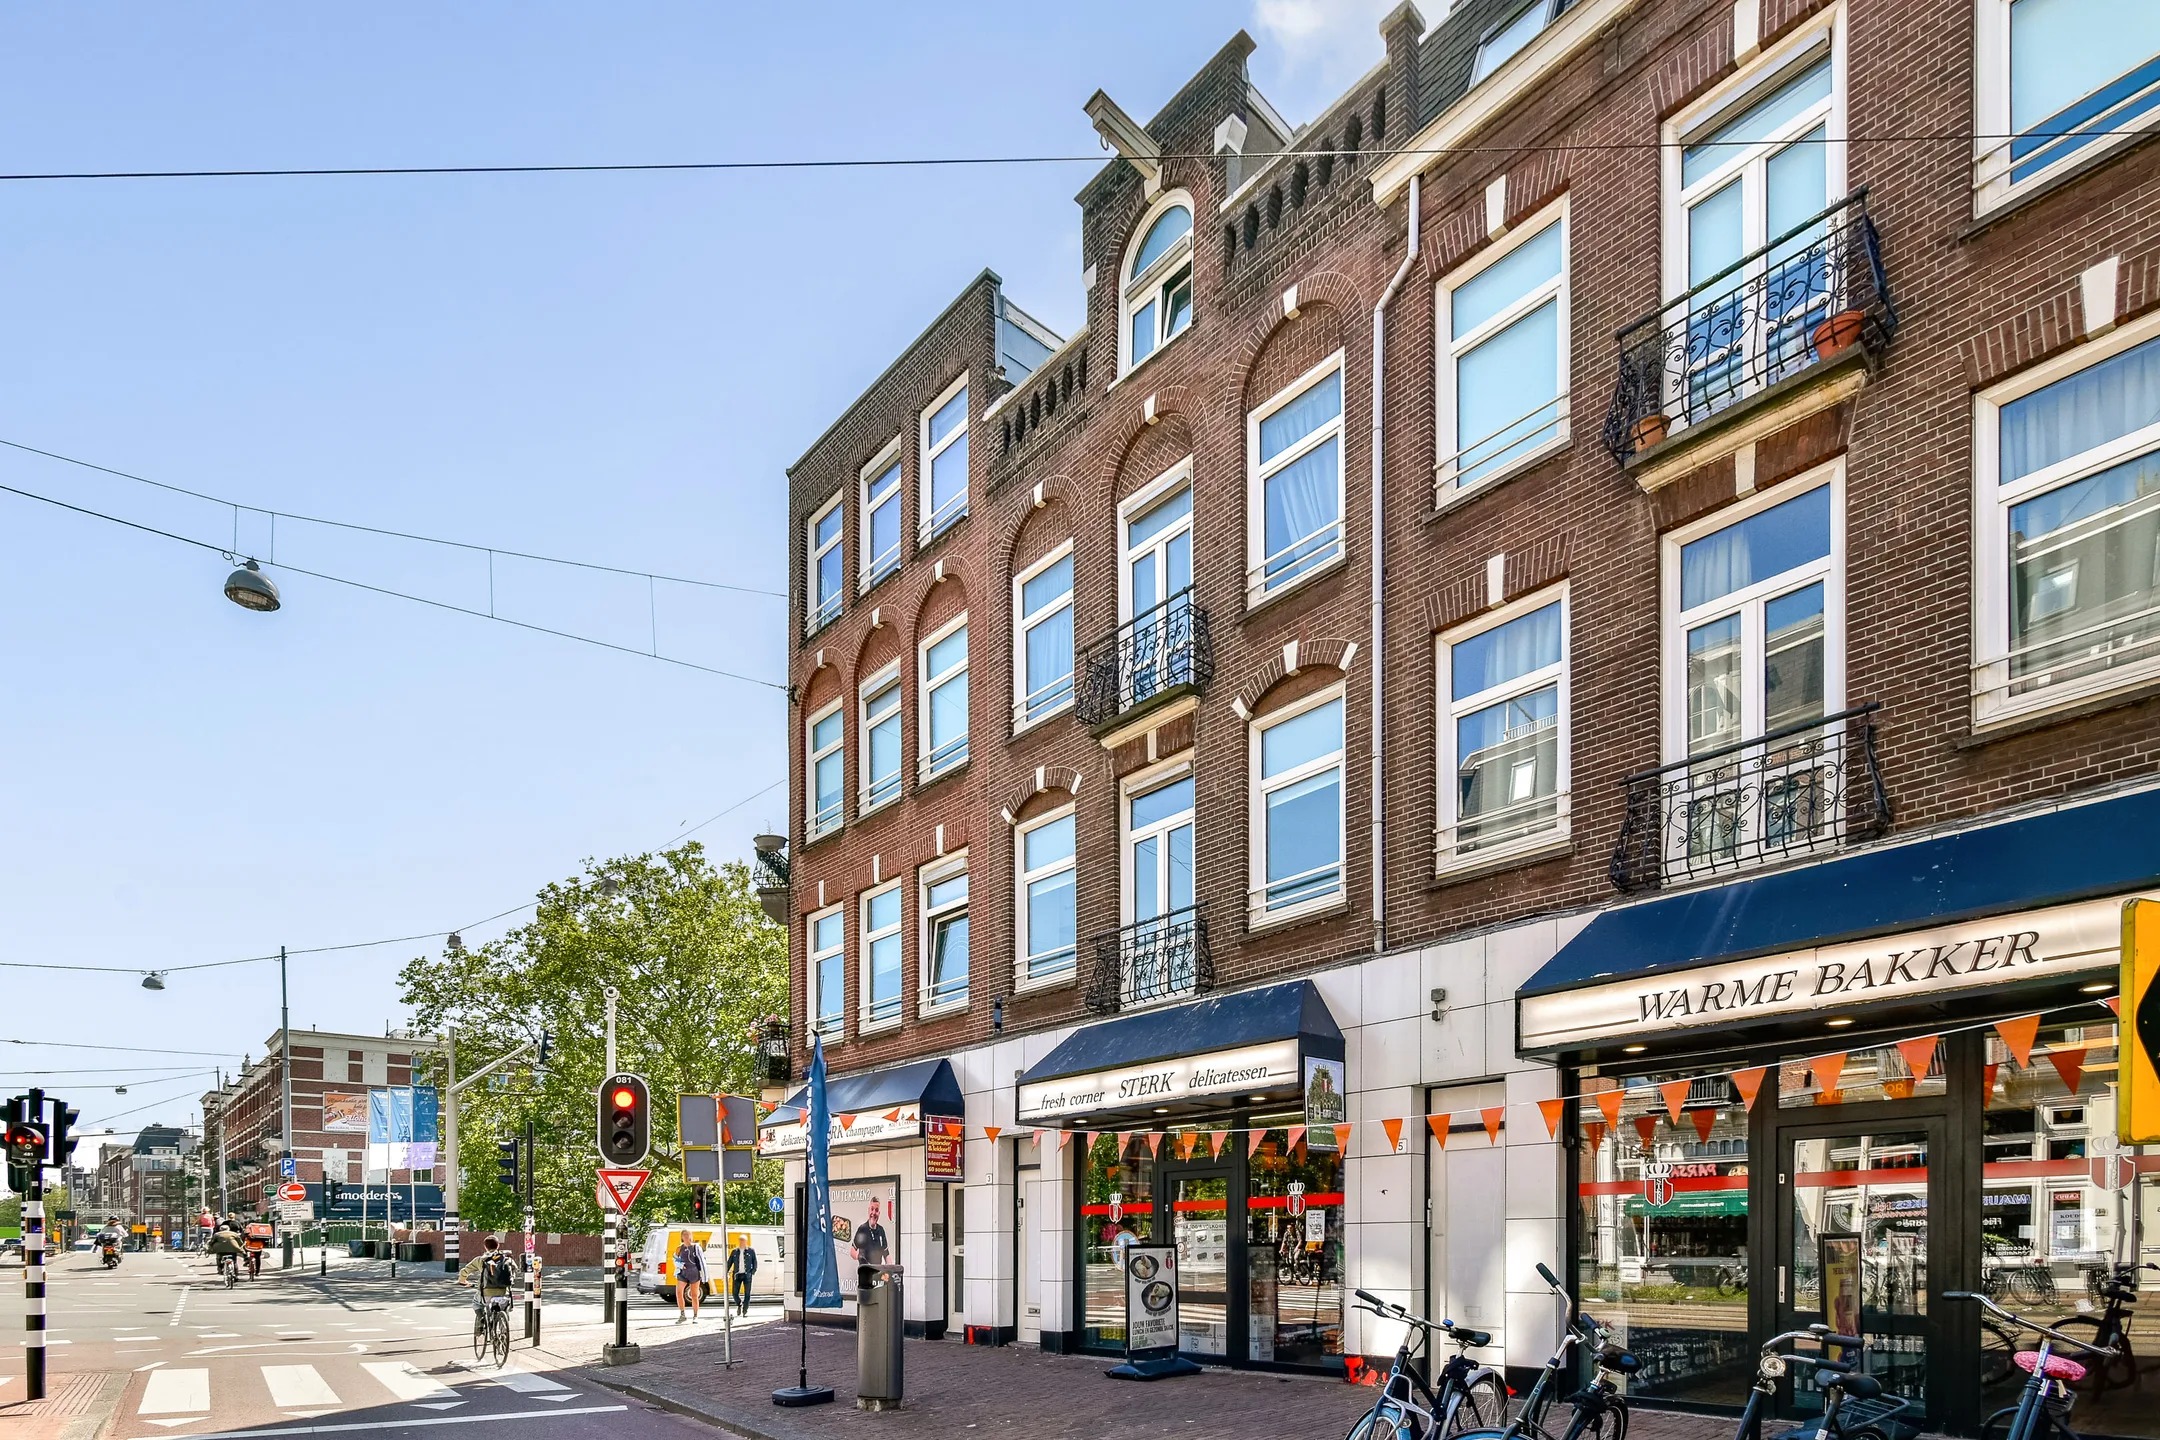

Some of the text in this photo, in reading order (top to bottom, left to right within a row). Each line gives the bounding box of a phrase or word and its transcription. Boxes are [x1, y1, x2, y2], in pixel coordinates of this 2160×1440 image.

[1638, 931, 2040, 1023] WARME BAKKER
[1040, 1066, 1268, 1110] fresh corner STERK delicatessen
[846, 1124, 884, 1139] champagne
[1398, 1142, 1403, 1150] 5
[340, 1190, 391, 1200] moeders
